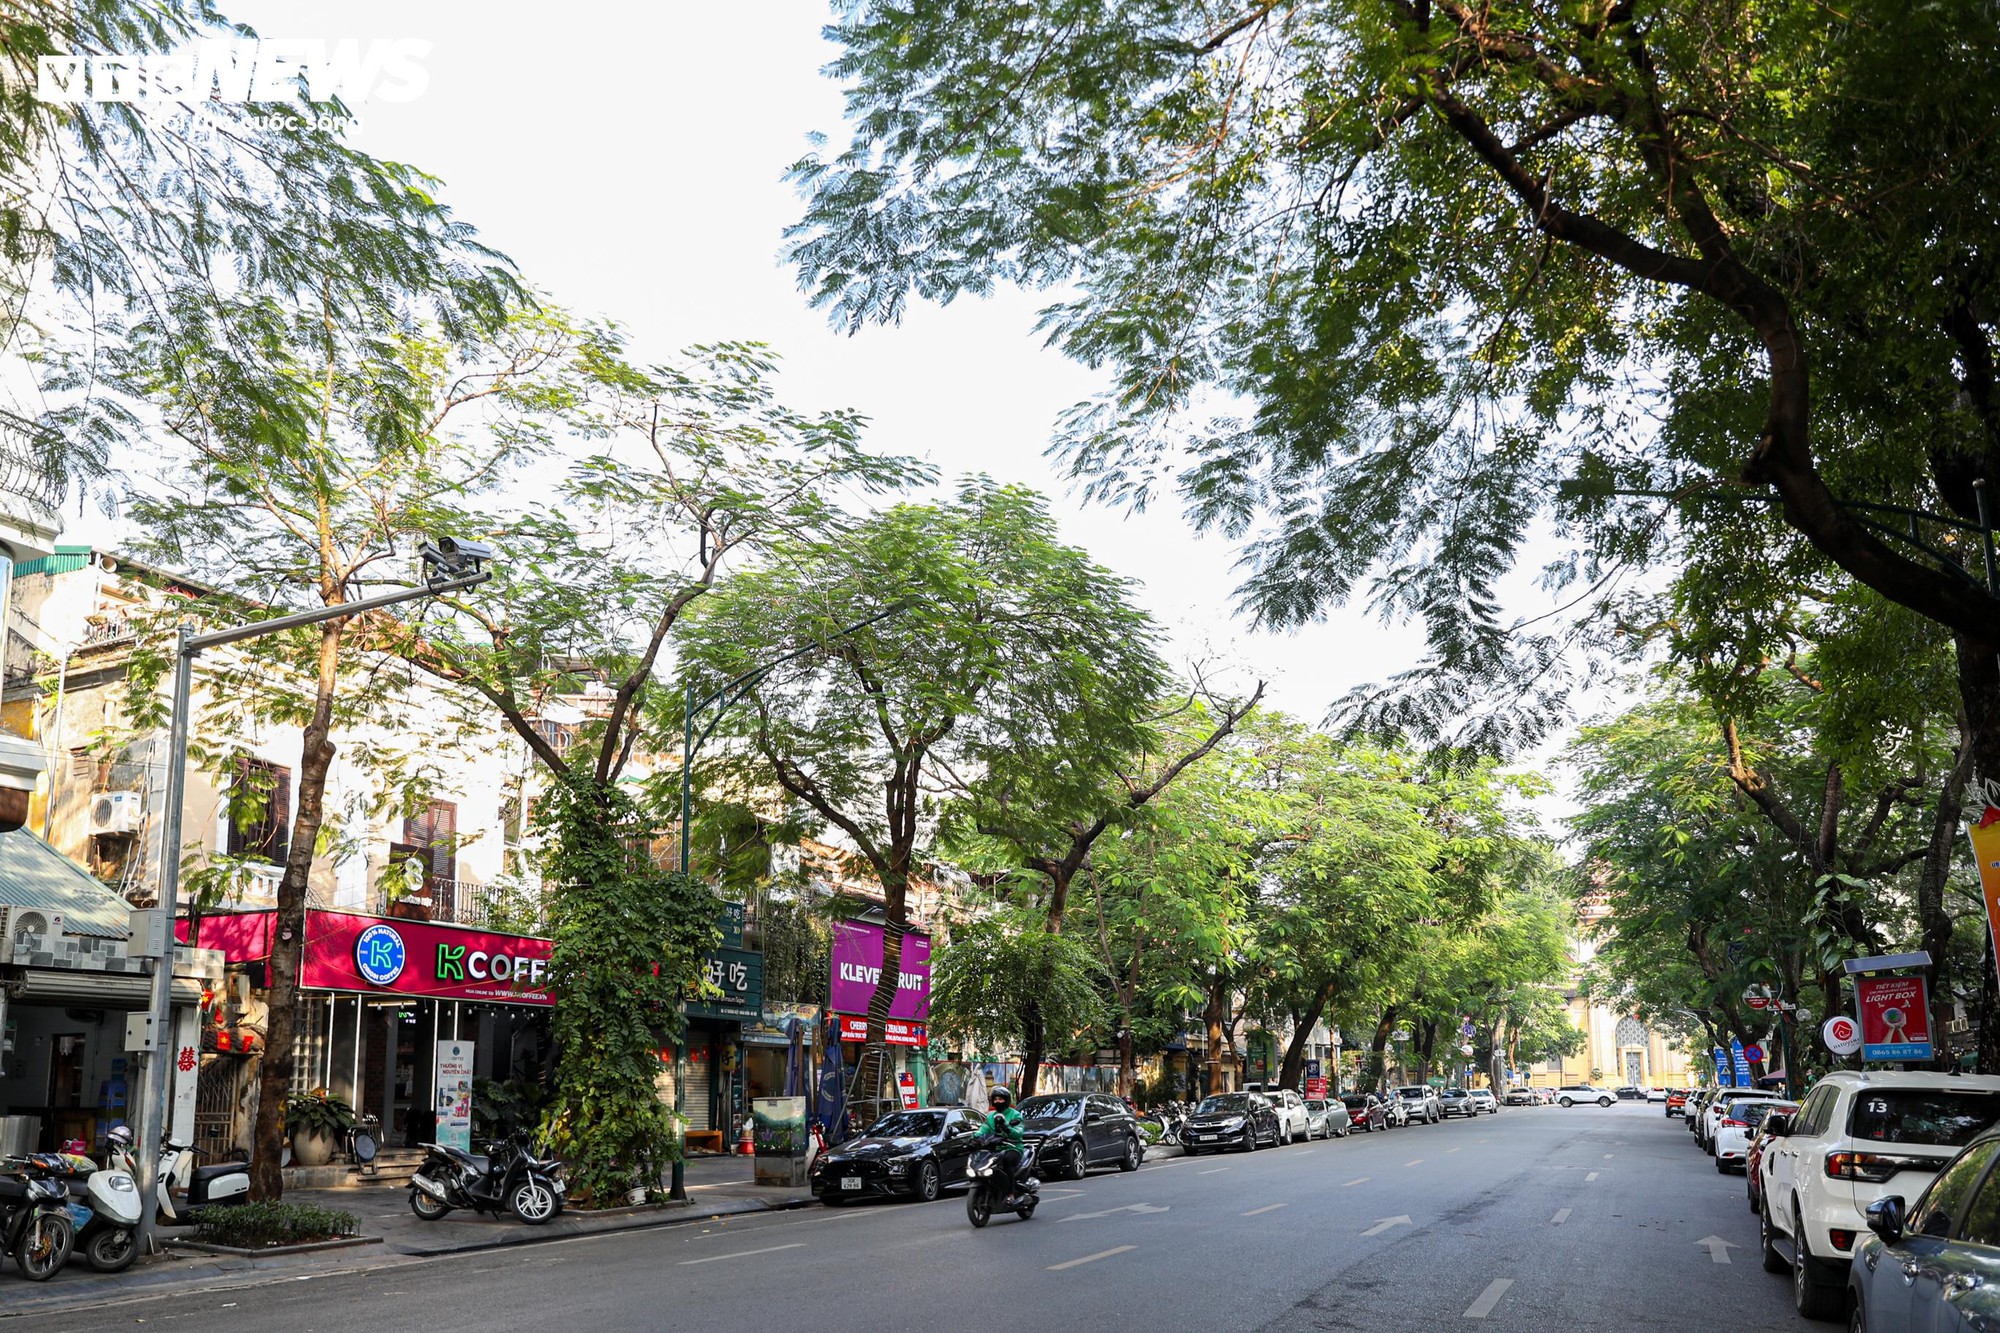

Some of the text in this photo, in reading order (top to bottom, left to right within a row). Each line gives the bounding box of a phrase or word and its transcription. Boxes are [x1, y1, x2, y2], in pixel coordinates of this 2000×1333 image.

[363, 928, 401, 949] 100% NATURAL
[379, 966, 399, 981] COFFEE
[706, 958, 748, 991] 好吃
[841, 962, 882, 985] KLEVE
[898, 972, 923, 991] RUIT
[1865, 990, 1917, 1003] LIGHT BOX
[1868, 1102, 1887, 1113] 13
